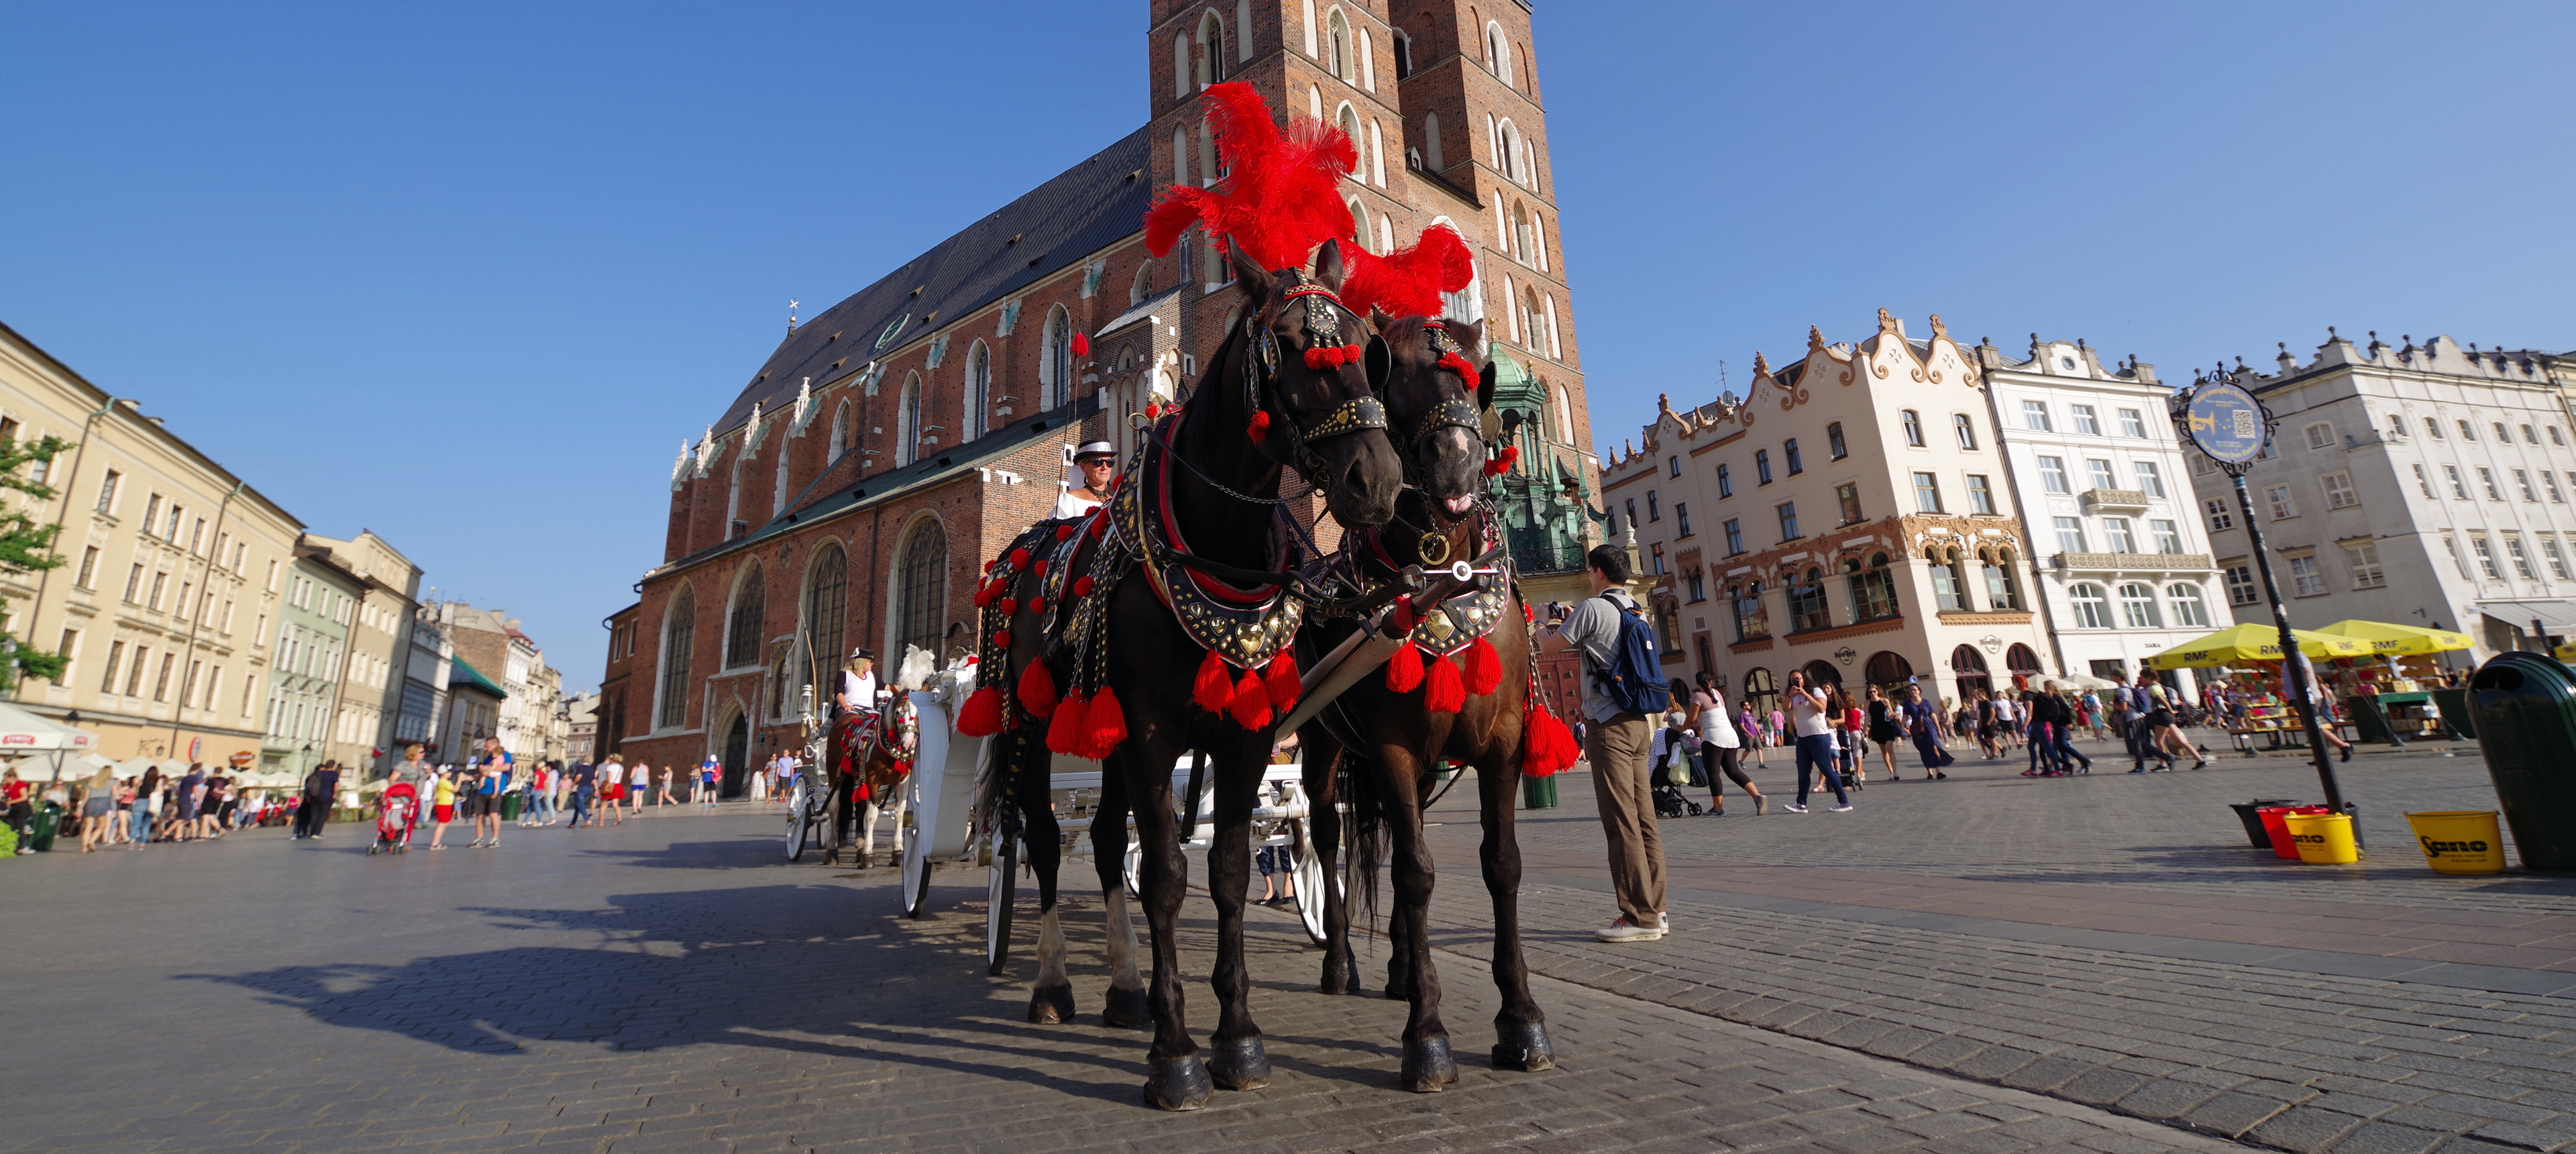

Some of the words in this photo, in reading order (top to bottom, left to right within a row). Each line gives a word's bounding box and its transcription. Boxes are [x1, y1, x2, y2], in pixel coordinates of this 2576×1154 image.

[2337, 641, 2354, 651] RMF
[1834, 651, 1845, 659] Hard
[1845, 649, 1856, 658] Rock
[2184, 651, 2208, 663] RMF
[2420, 836, 2487, 857] Sano
